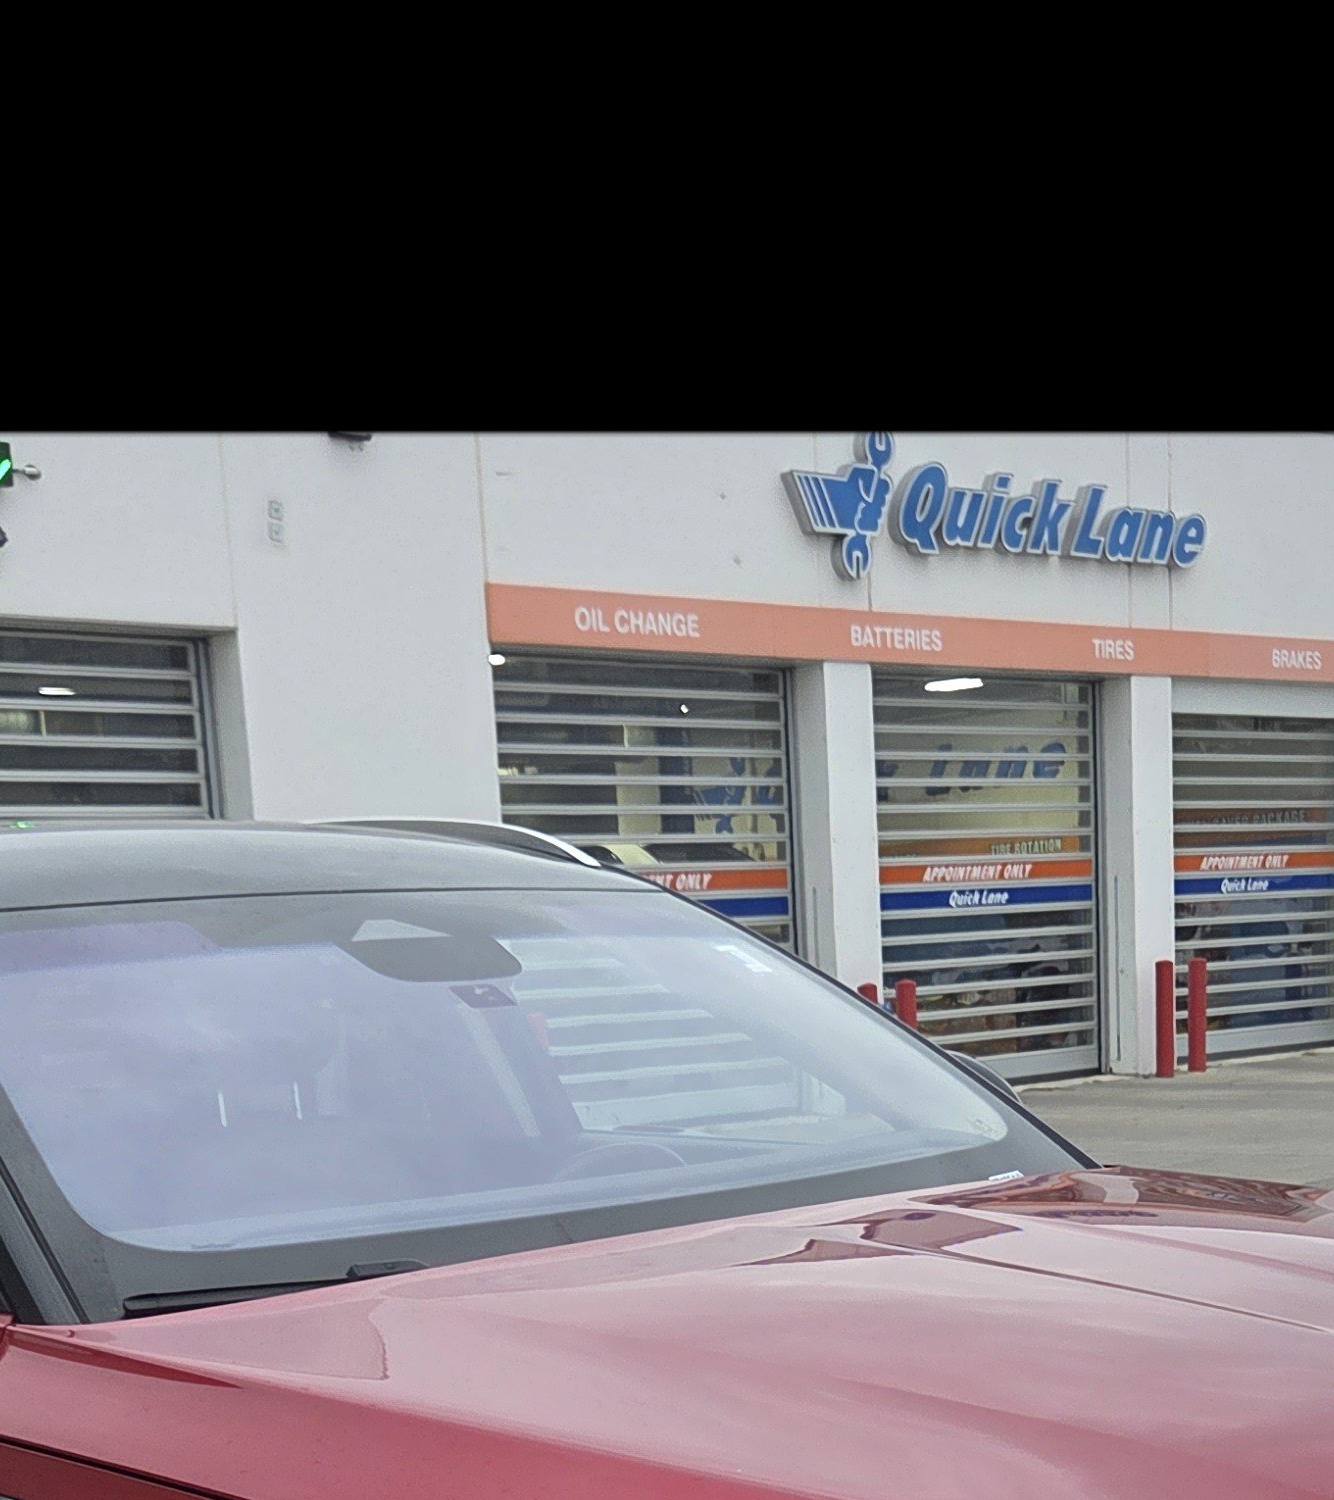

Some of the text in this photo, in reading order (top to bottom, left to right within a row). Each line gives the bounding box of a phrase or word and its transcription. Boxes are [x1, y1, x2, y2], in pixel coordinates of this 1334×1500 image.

[897, 461, 1207, 568] Quick Lane
[574, 606, 700, 639] OIL CHANGE
[850, 626, 943, 652] BATTERIES
[1093, 638, 1135, 661] TIRES
[1272, 648, 1323, 671] BRAKES
[923, 863, 1033, 882] APPOINTMENT ONLY
[1200, 854, 1289, 870] APPOINTMENT ONLY
[676, 872, 713, 890] ONLY
[1221, 877, 1269, 894] Quick Lane
[949, 889, 1009, 907] Quick Lane
